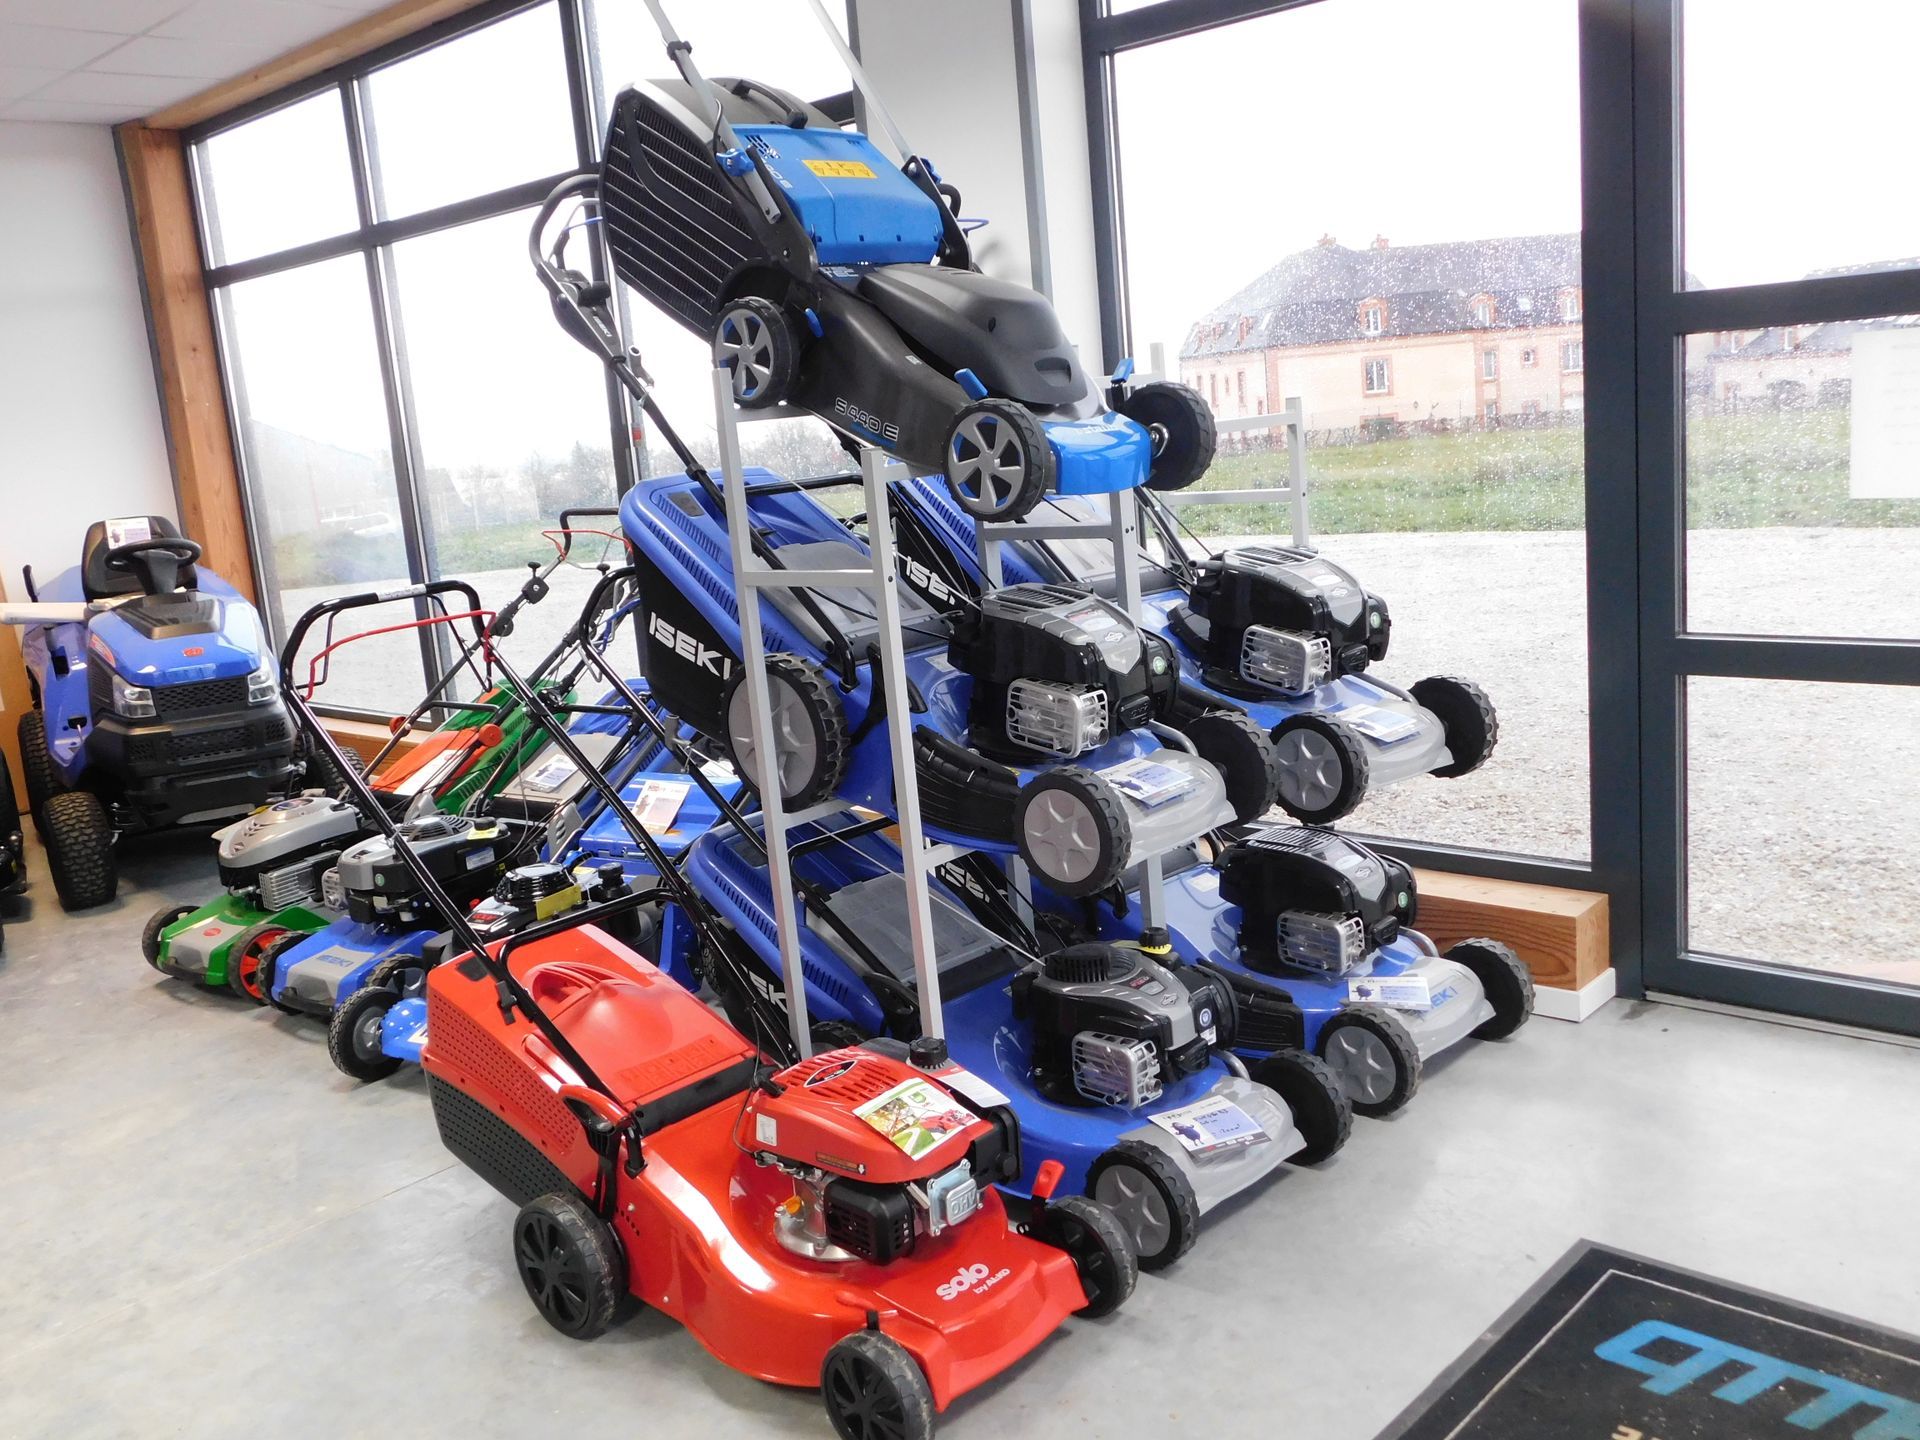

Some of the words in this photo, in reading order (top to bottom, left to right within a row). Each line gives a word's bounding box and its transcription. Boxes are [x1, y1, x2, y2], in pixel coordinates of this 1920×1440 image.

[834, 397, 848, 416] S
[847, 405, 881, 434] 440
[883, 422, 899, 441] E
[906, 555, 956, 606] ISE
[648, 610, 731, 681] ISEKI
[951, 1190, 976, 1215] OHV
[936, 1263, 989, 1301] solo
